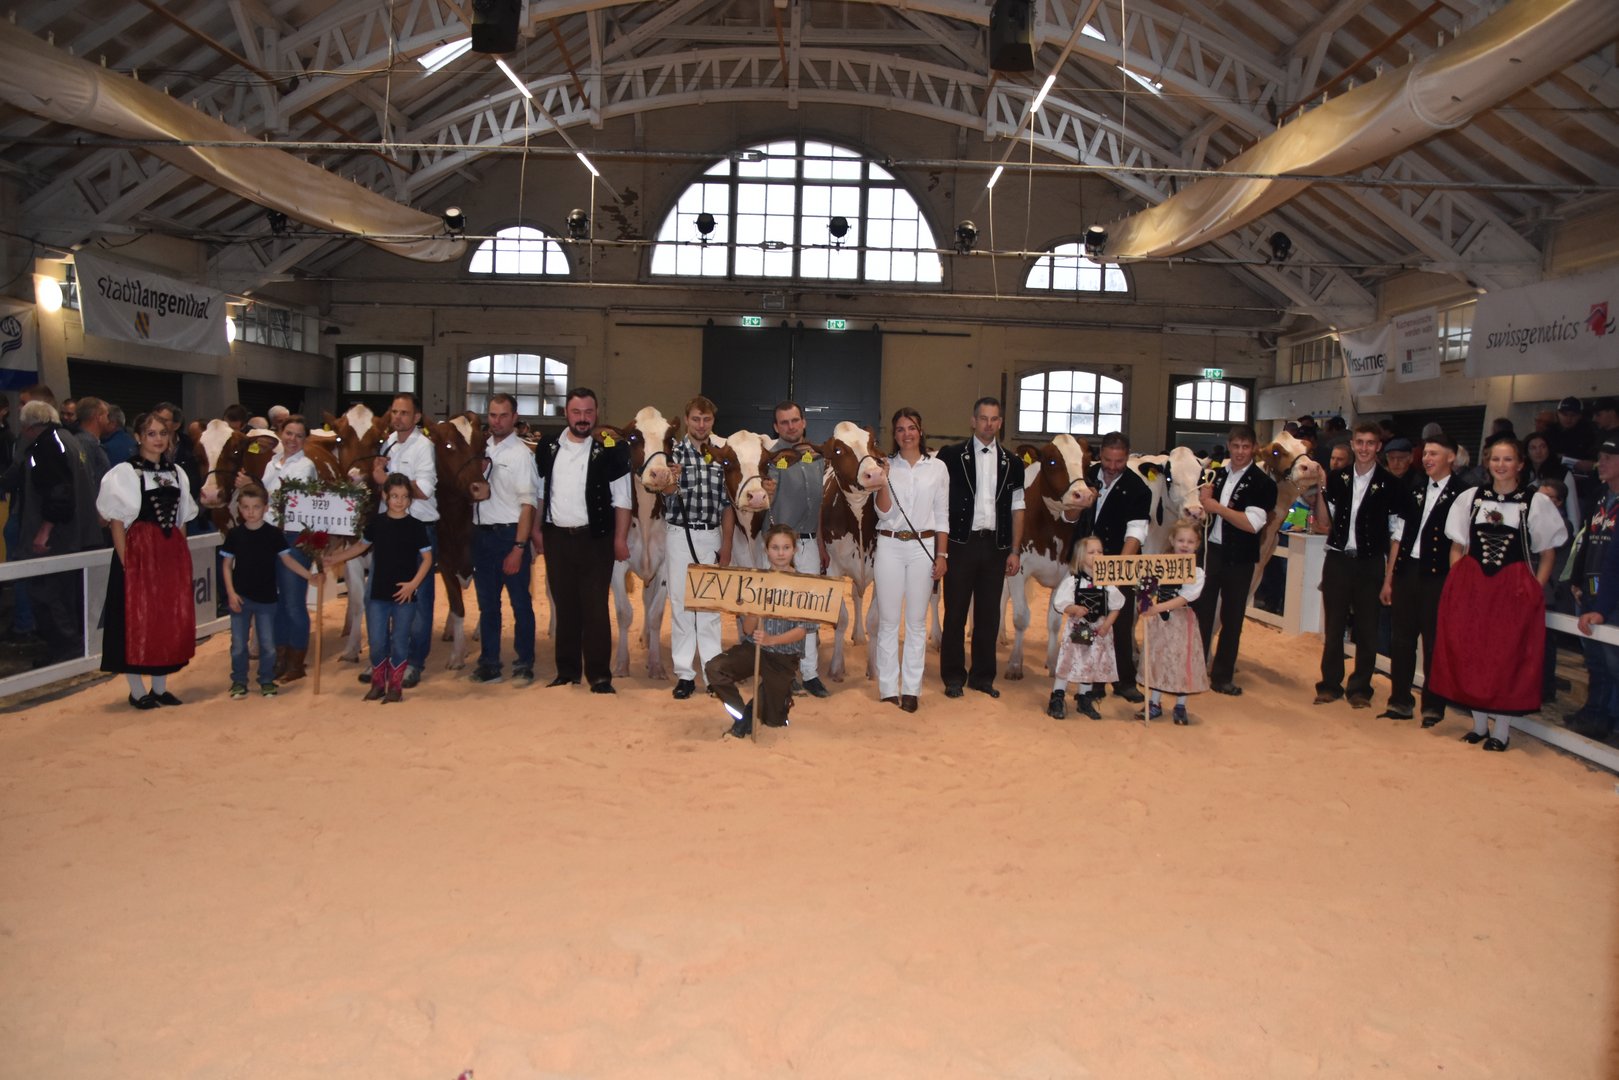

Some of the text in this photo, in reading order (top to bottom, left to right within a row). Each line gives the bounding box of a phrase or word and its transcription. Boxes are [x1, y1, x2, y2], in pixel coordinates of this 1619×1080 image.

[97, 274, 210, 319] stadtlangenthal
[1486, 315, 1580, 353] swissgenetics
[1094, 557, 1194, 581] WALTERSWIL
[688, 571, 833, 613] VZV Bipperamt
